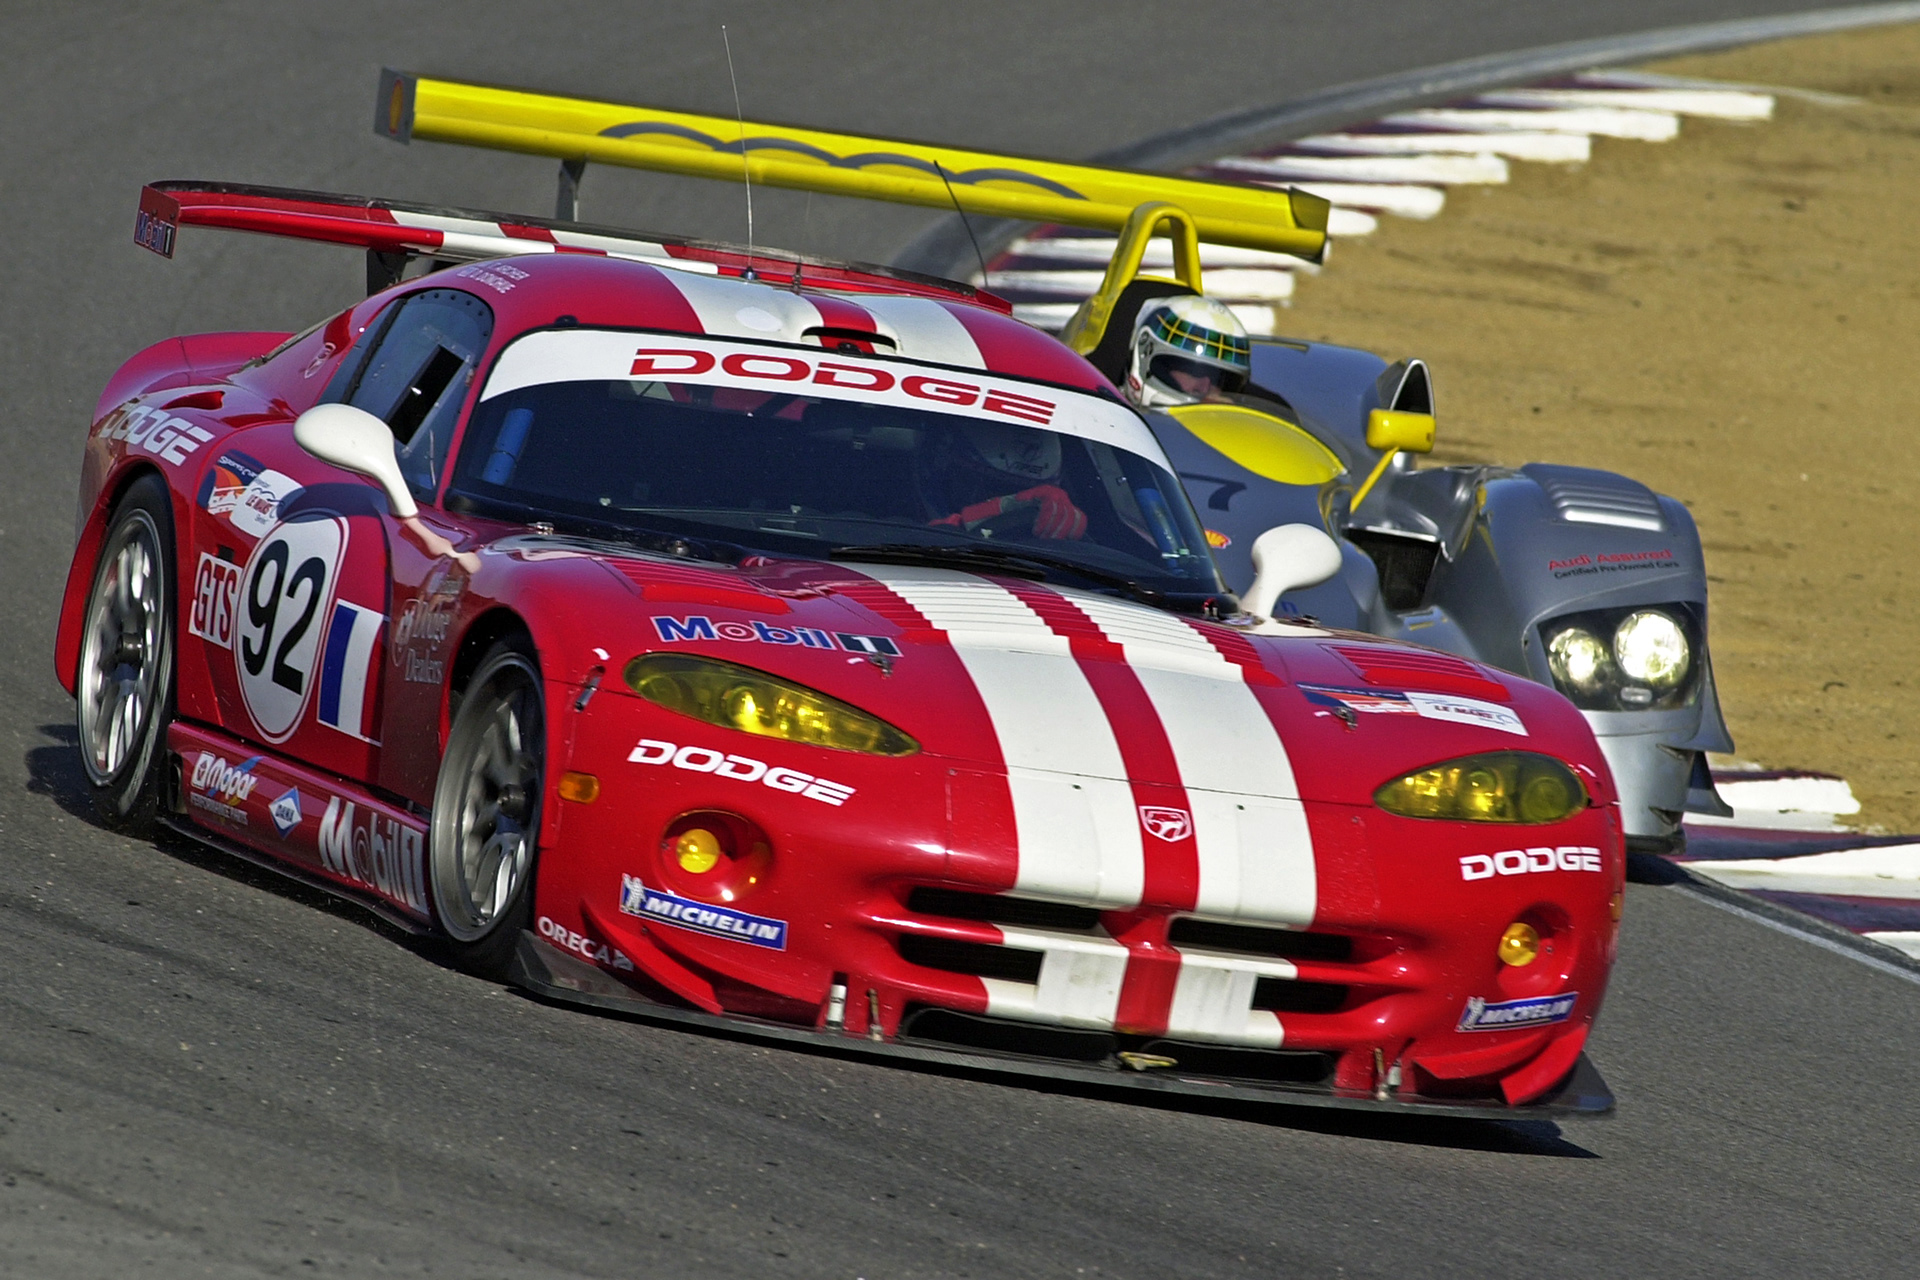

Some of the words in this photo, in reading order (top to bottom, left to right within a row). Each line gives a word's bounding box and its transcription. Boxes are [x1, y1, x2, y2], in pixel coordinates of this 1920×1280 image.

[630, 348, 1057, 425] DODGE
[99, 402, 216, 467] DODGE
[1549, 554, 1591, 570] Audi
[1597, 549, 1673, 563] Assured
[1554, 565, 1599, 579] Certified
[1600, 561, 1655, 573] Pre-Owned
[1656, 560, 1680, 569] Cars
[194, 558, 238, 643] GTS
[242, 539, 326, 696] 92
[650, 616, 838, 650] Mobil
[626, 738, 857, 806] DODGE
[319, 795, 406, 905] Mobil
[1459, 845, 1602, 881] DODGE
[538, 916, 611, 965] ORECA
[644, 895, 782, 940] MICHELIN
[1480, 1000, 1574, 1023] MICHELIN
